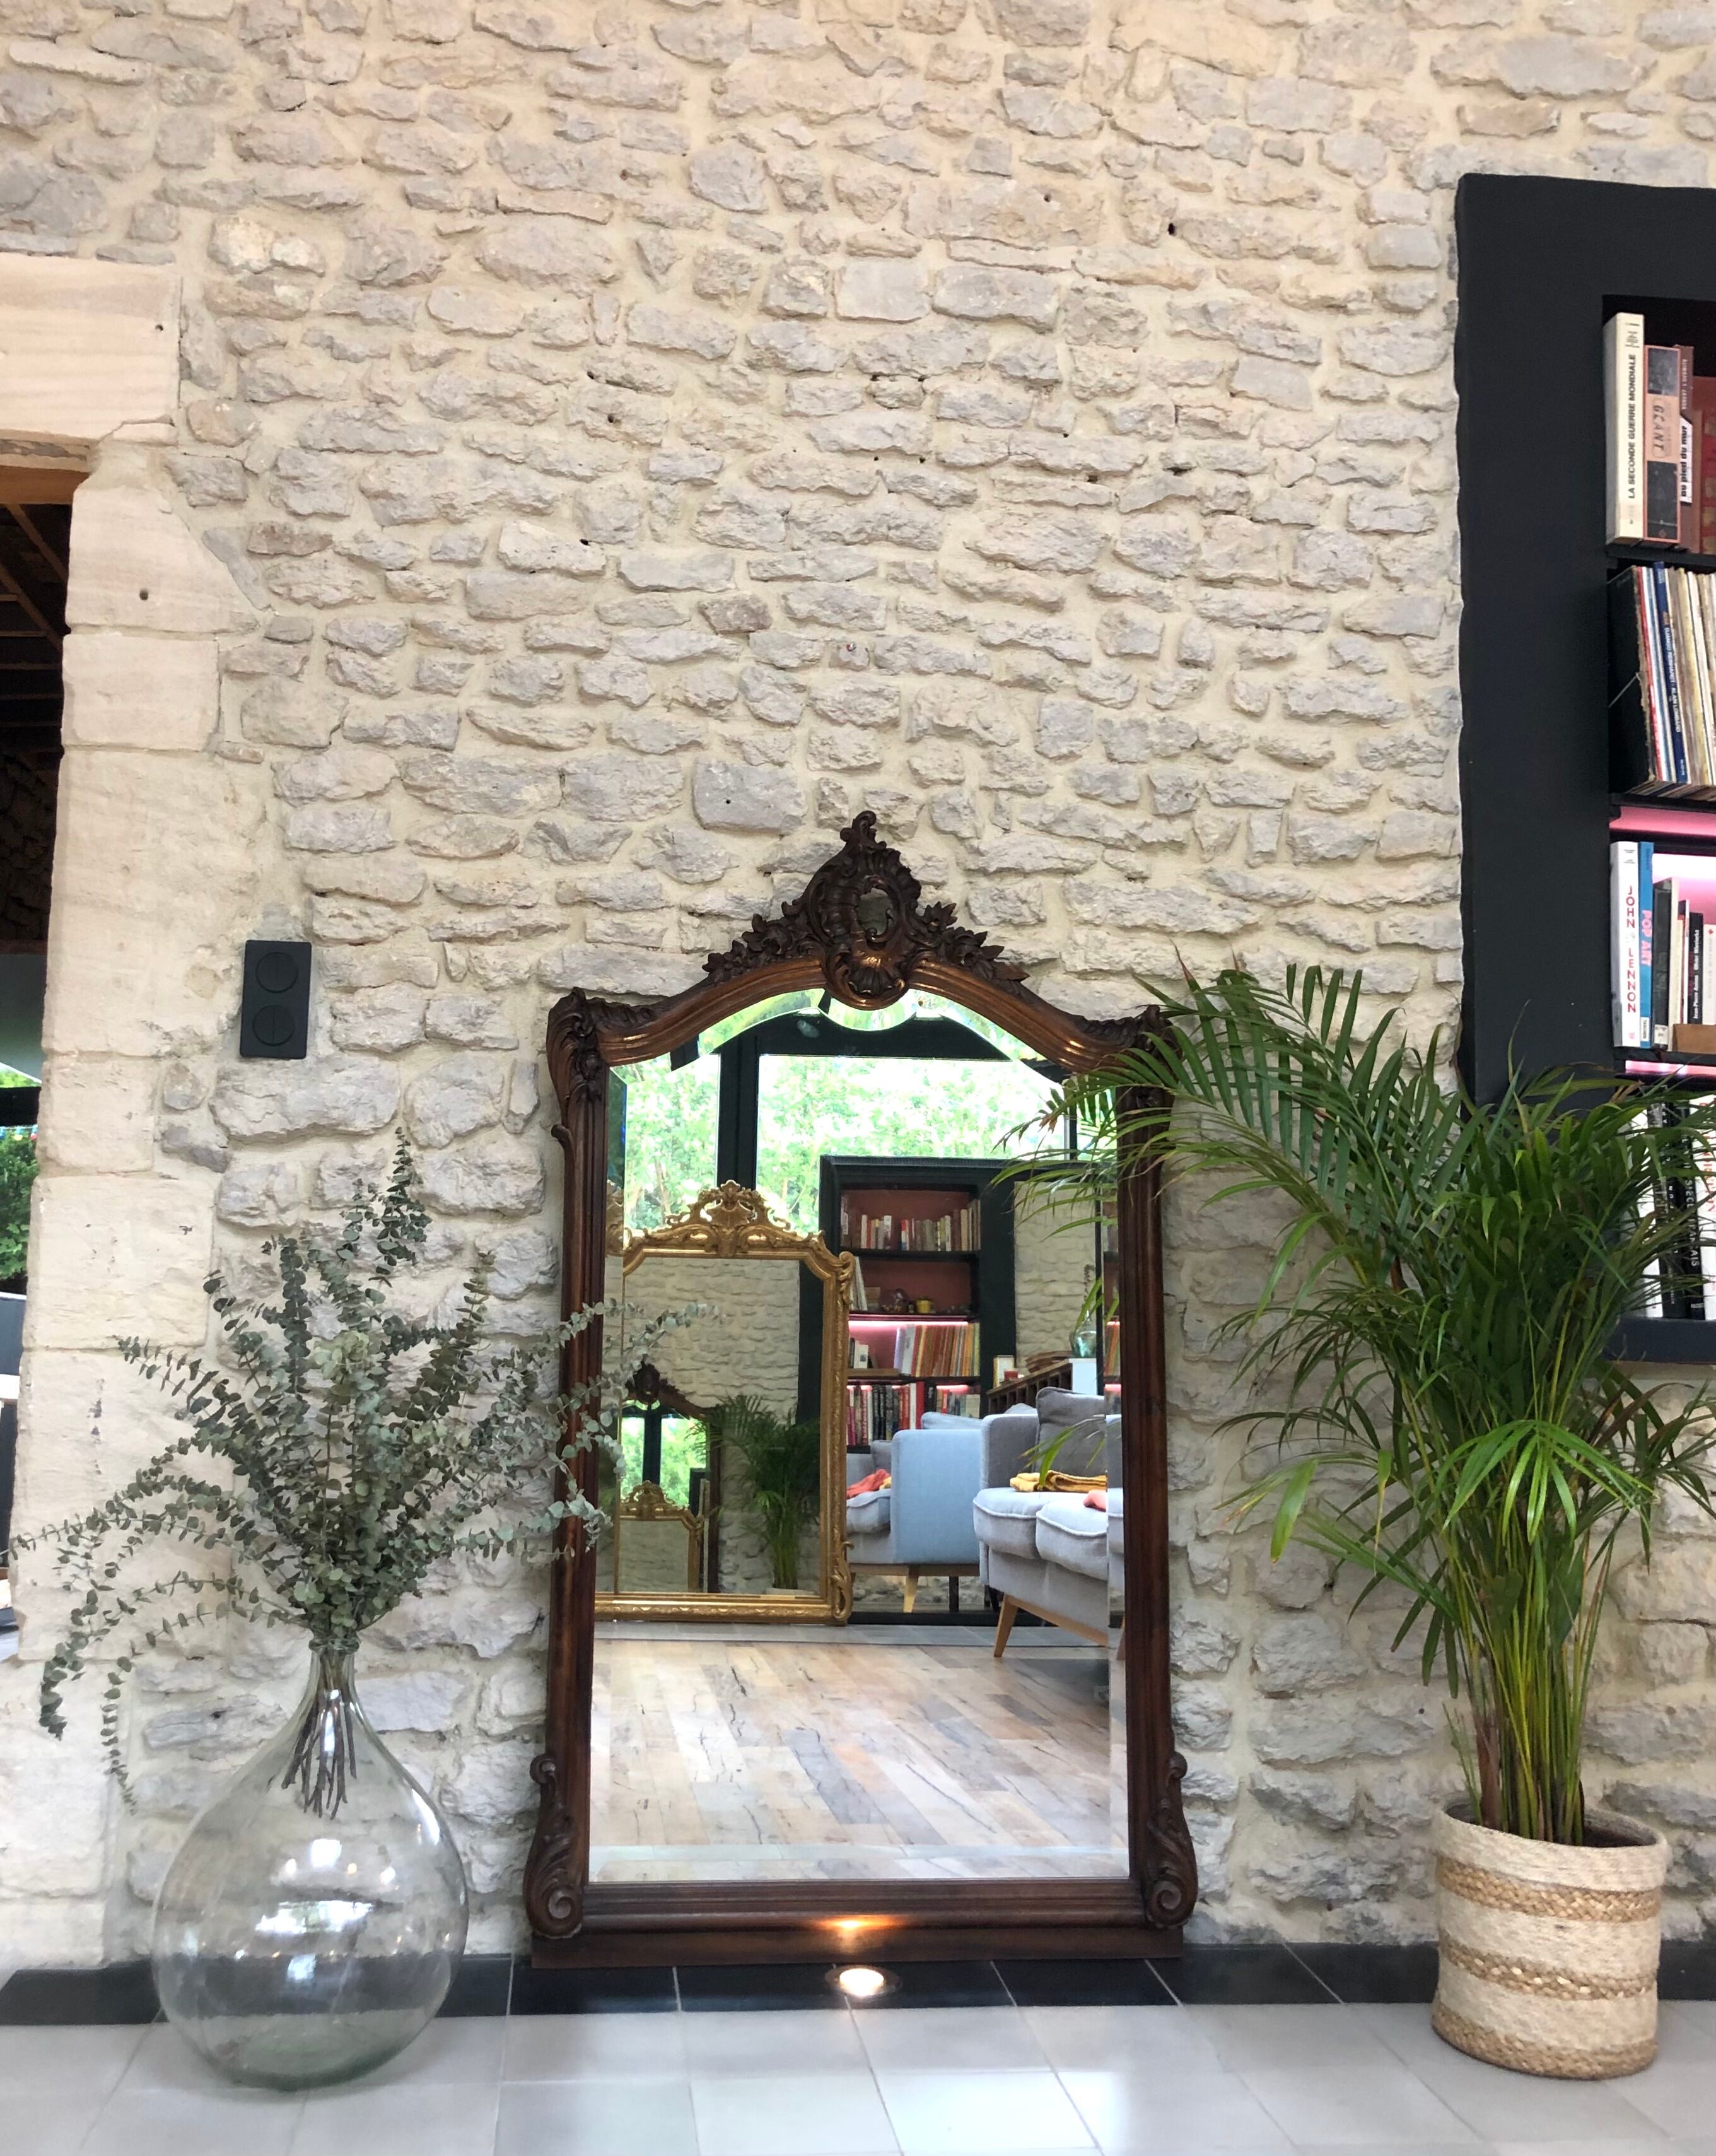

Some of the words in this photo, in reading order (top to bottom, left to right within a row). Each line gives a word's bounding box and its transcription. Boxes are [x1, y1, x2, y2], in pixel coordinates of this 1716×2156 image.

[1681, 447, 1687, 459] du
[1628, 488, 1635, 499] LA
[1626, 886, 1635, 929] JOHN
[1641, 910, 1652, 937] POP
[1640, 940, 1652, 966] ART
[1627, 947, 1636, 1013] LENNON
